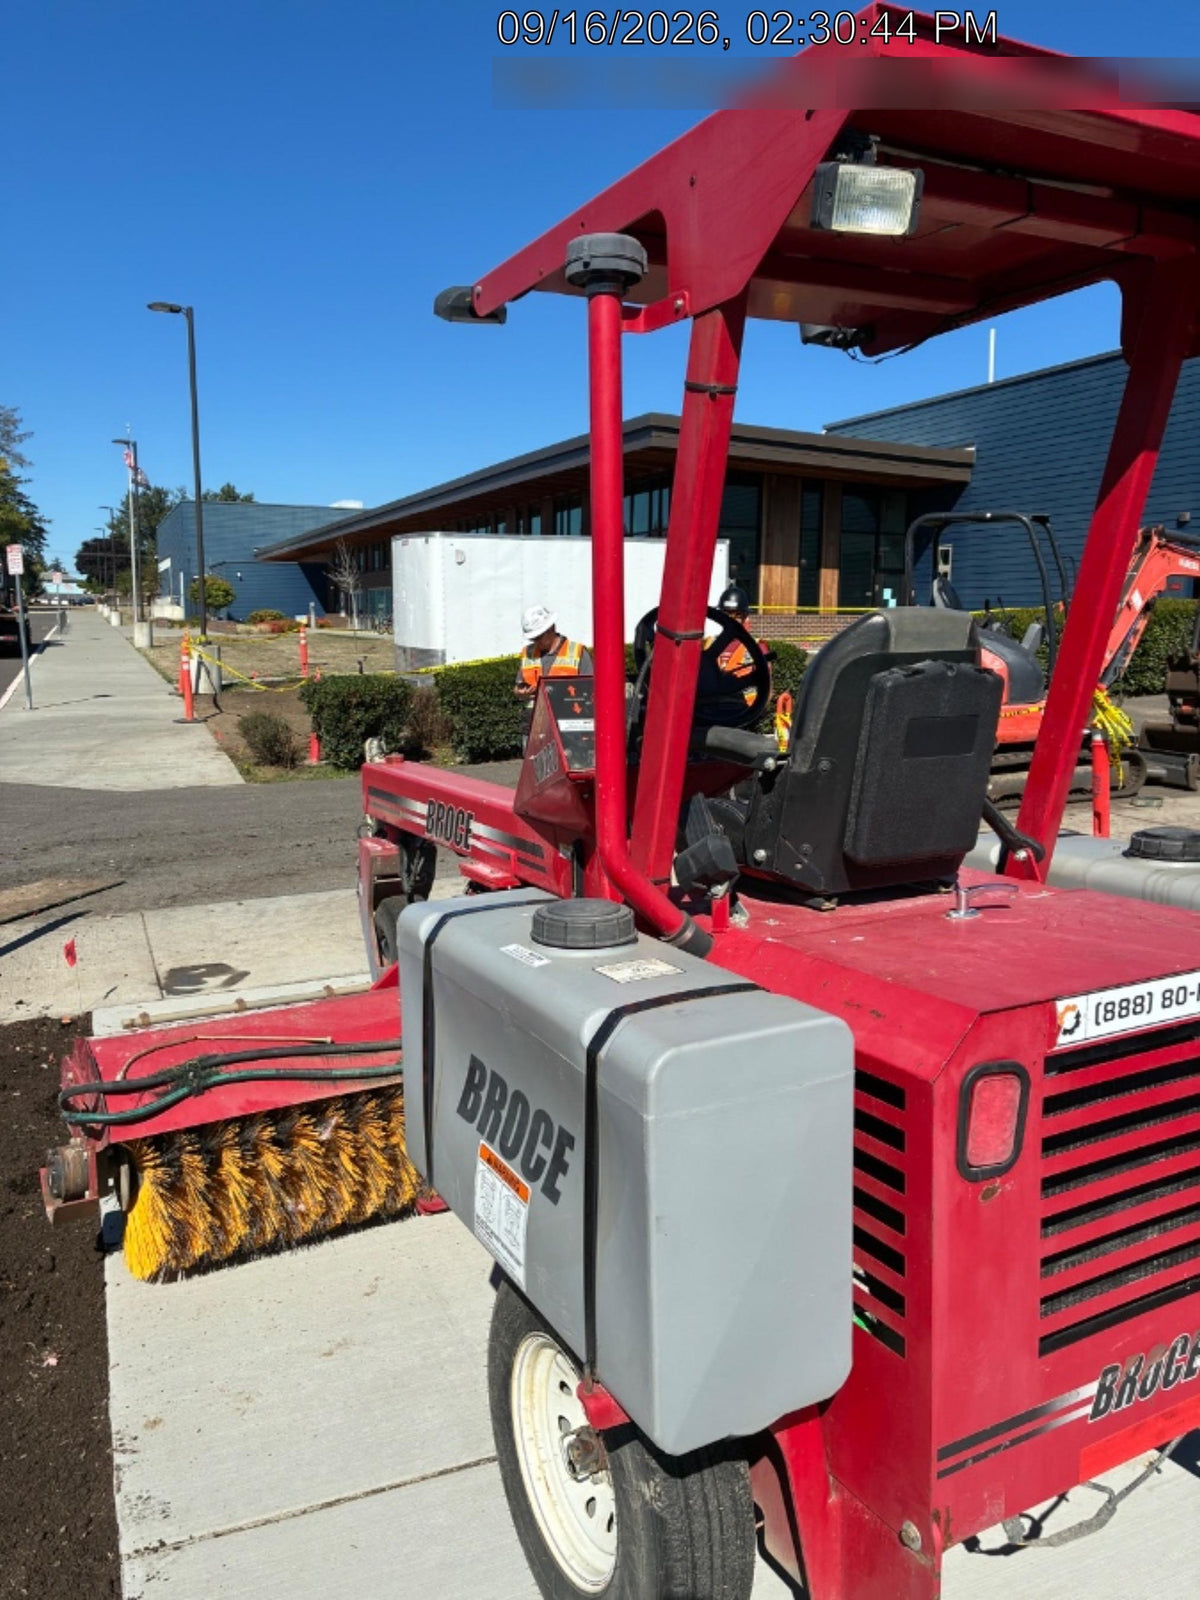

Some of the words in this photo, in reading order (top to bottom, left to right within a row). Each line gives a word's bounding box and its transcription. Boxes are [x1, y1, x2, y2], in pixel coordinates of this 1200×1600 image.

[426, 798, 475, 851] BROCE
[1094, 991, 1153, 1026] (888)
[456, 1053, 576, 1207] BROCE
